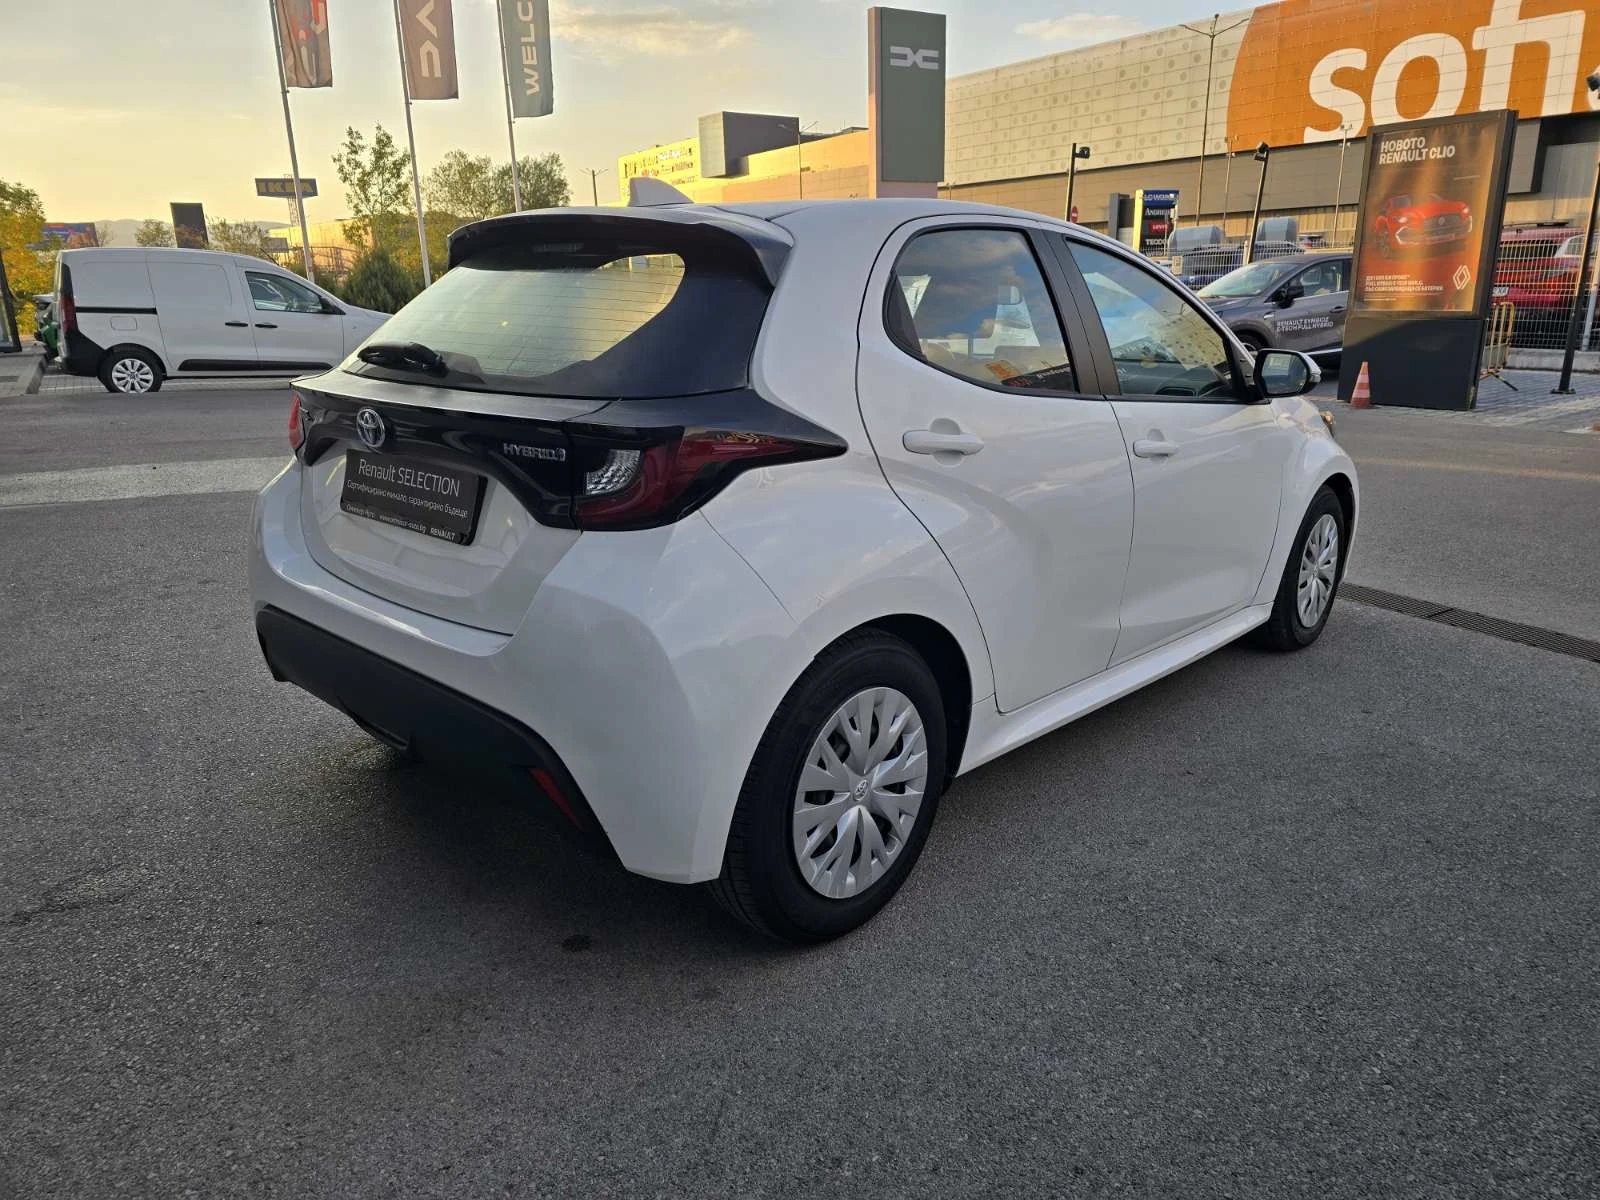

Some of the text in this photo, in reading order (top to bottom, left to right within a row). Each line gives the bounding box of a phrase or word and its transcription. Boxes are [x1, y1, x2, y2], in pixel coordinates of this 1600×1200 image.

[1379, 145, 1456, 165] RENAULT CLIO
[1277, 319, 1304, 327] RENAULT
[503, 443, 557, 460] HYBRID
[358, 458, 460, 497] Renault SELECTION
[430, 527, 456, 541] RENAULT
